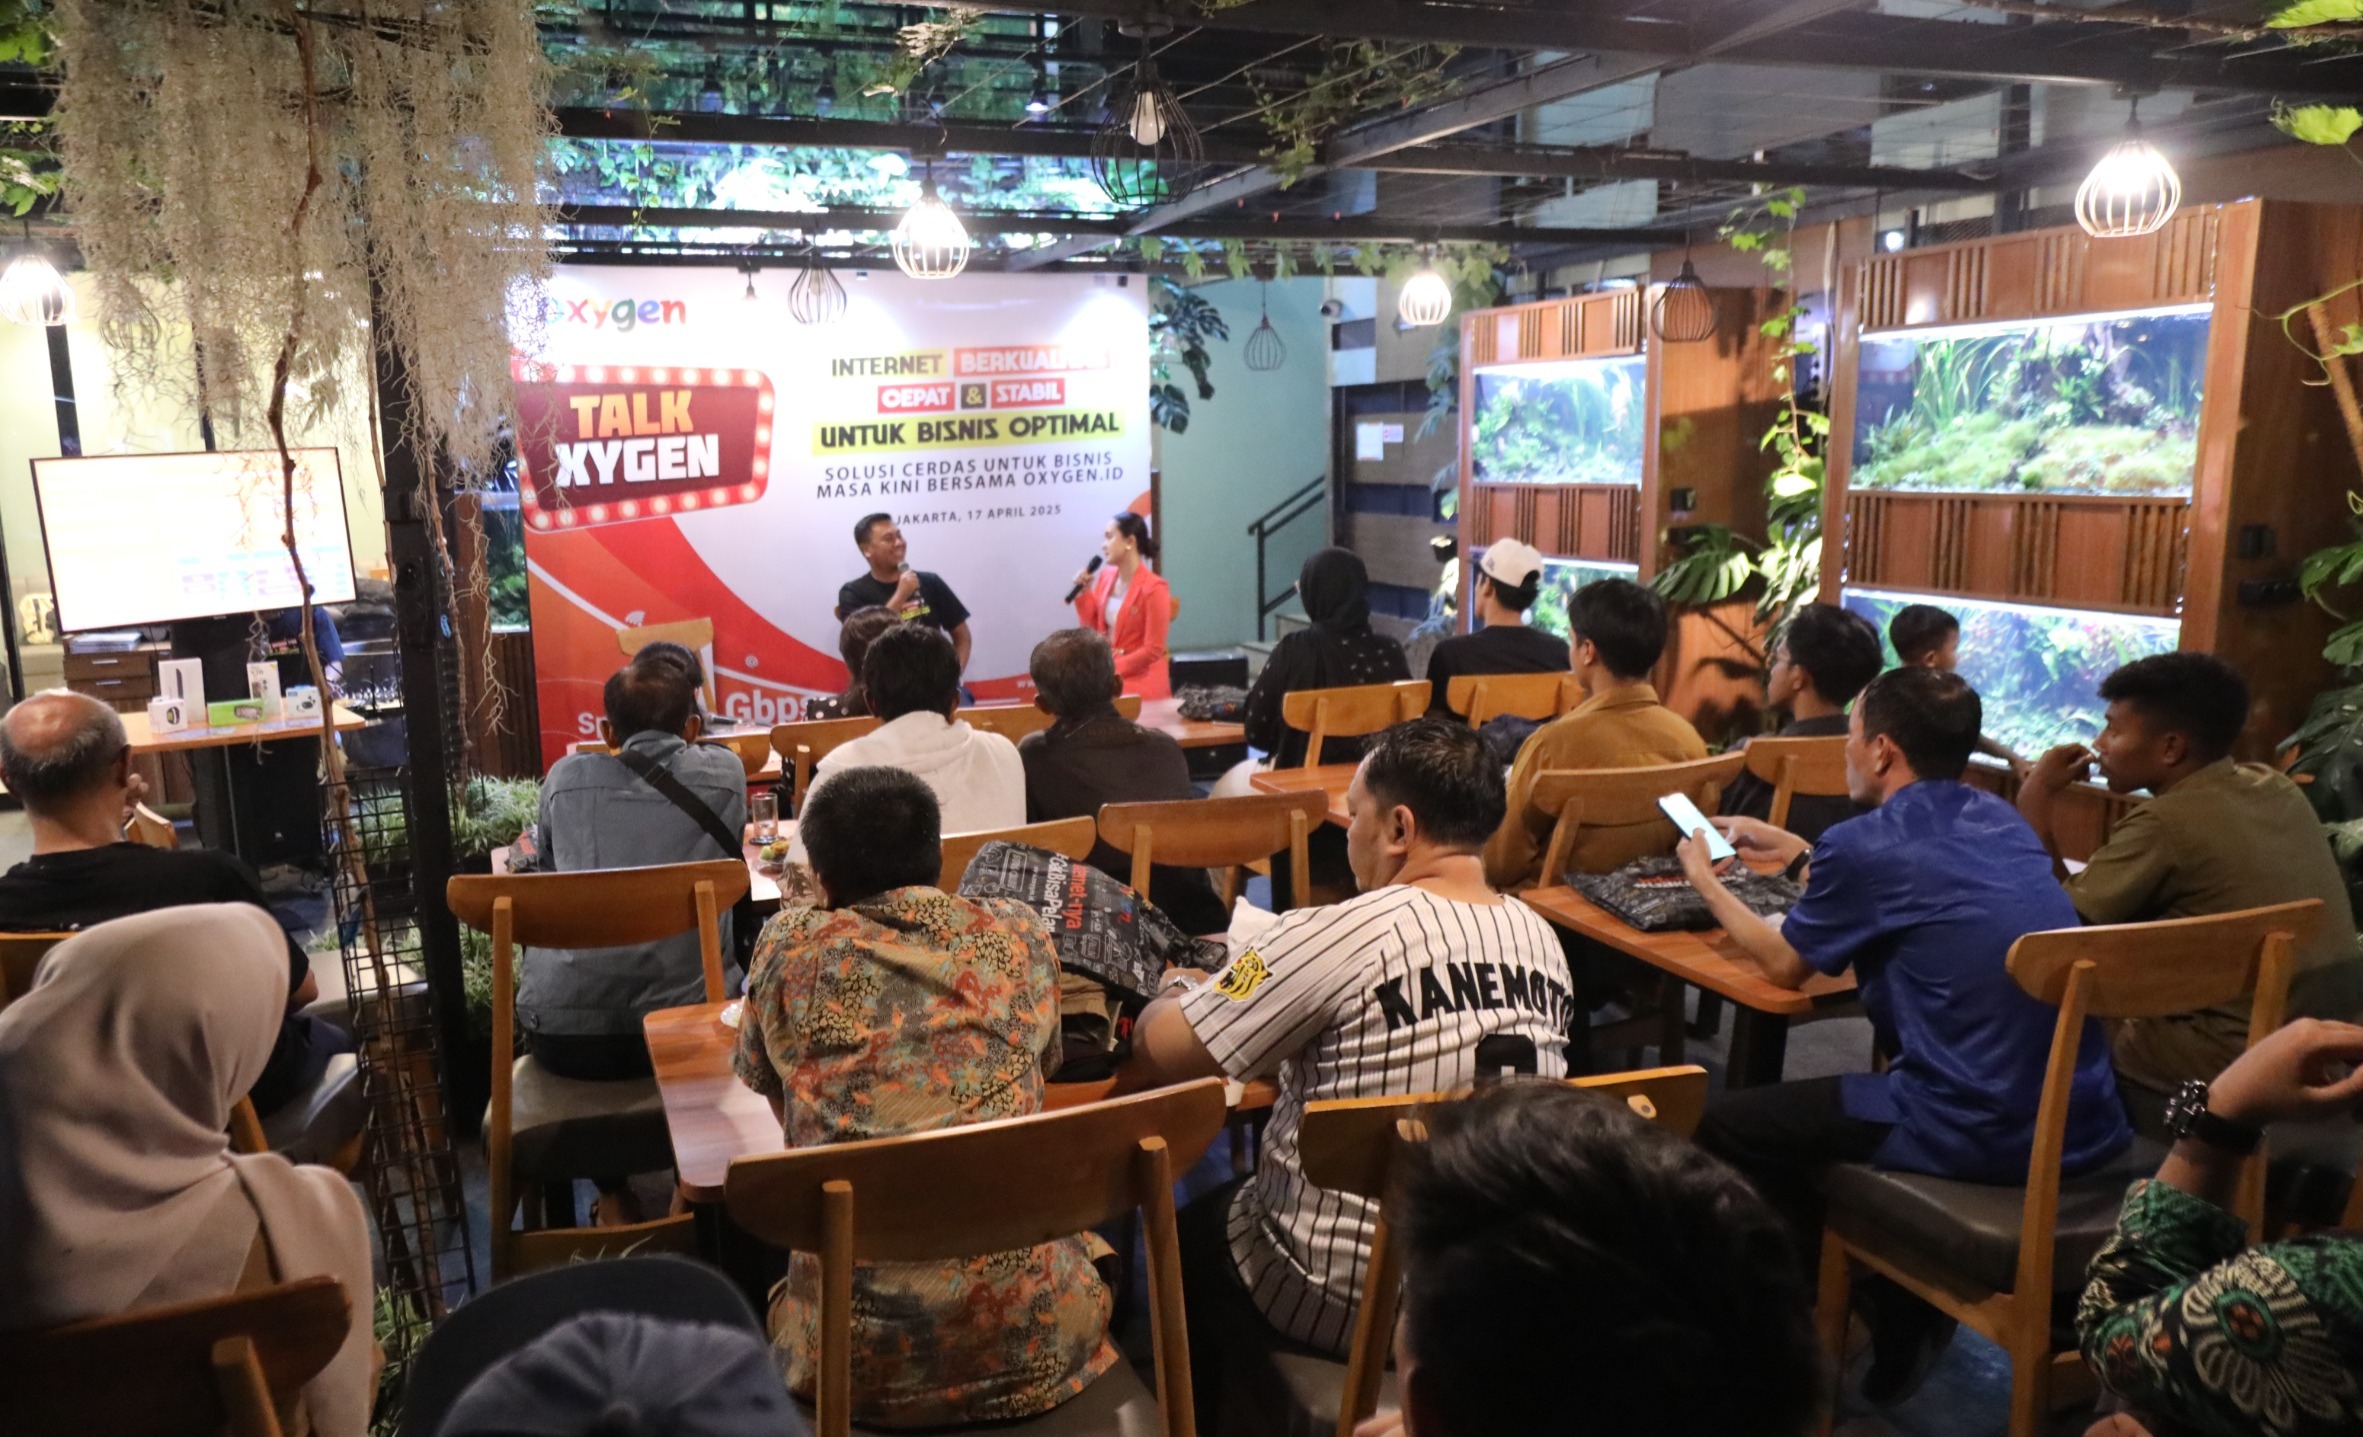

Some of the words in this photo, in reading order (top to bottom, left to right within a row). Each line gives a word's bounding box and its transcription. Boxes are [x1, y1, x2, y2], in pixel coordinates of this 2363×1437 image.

[831, 354, 944, 377] INTERNET
[880, 386, 951, 409] CEPAT
[965, 385, 983, 405] &
[996, 381, 1061, 403] STABIL
[569, 390, 694, 439] TALK
[820, 423, 906, 449] UNTUK
[917, 417, 1000, 443] BISNIS
[1008, 411, 1120, 438] OPTIMAL
[825, 463, 895, 482] SOLUSI
[903, 459, 977, 477] CERDAS
[984, 456, 1047, 473] UNTUK
[1054, 451, 1113, 468] BISNIS
[816, 482, 872, 499] MASA
[880, 479, 919, 495] KINI
[927, 475, 1017, 492] BERSAMA
[1024, 467, 1124, 487] OXYGEN.ID
[896, 511, 962, 525] JAKARTA,
[967, 509, 982, 521] 17
[987, 507, 1025, 519] APRIL
[1030, 504, 1061, 516] 2025
[1373, 961, 1575, 1037] KANEMOTO
